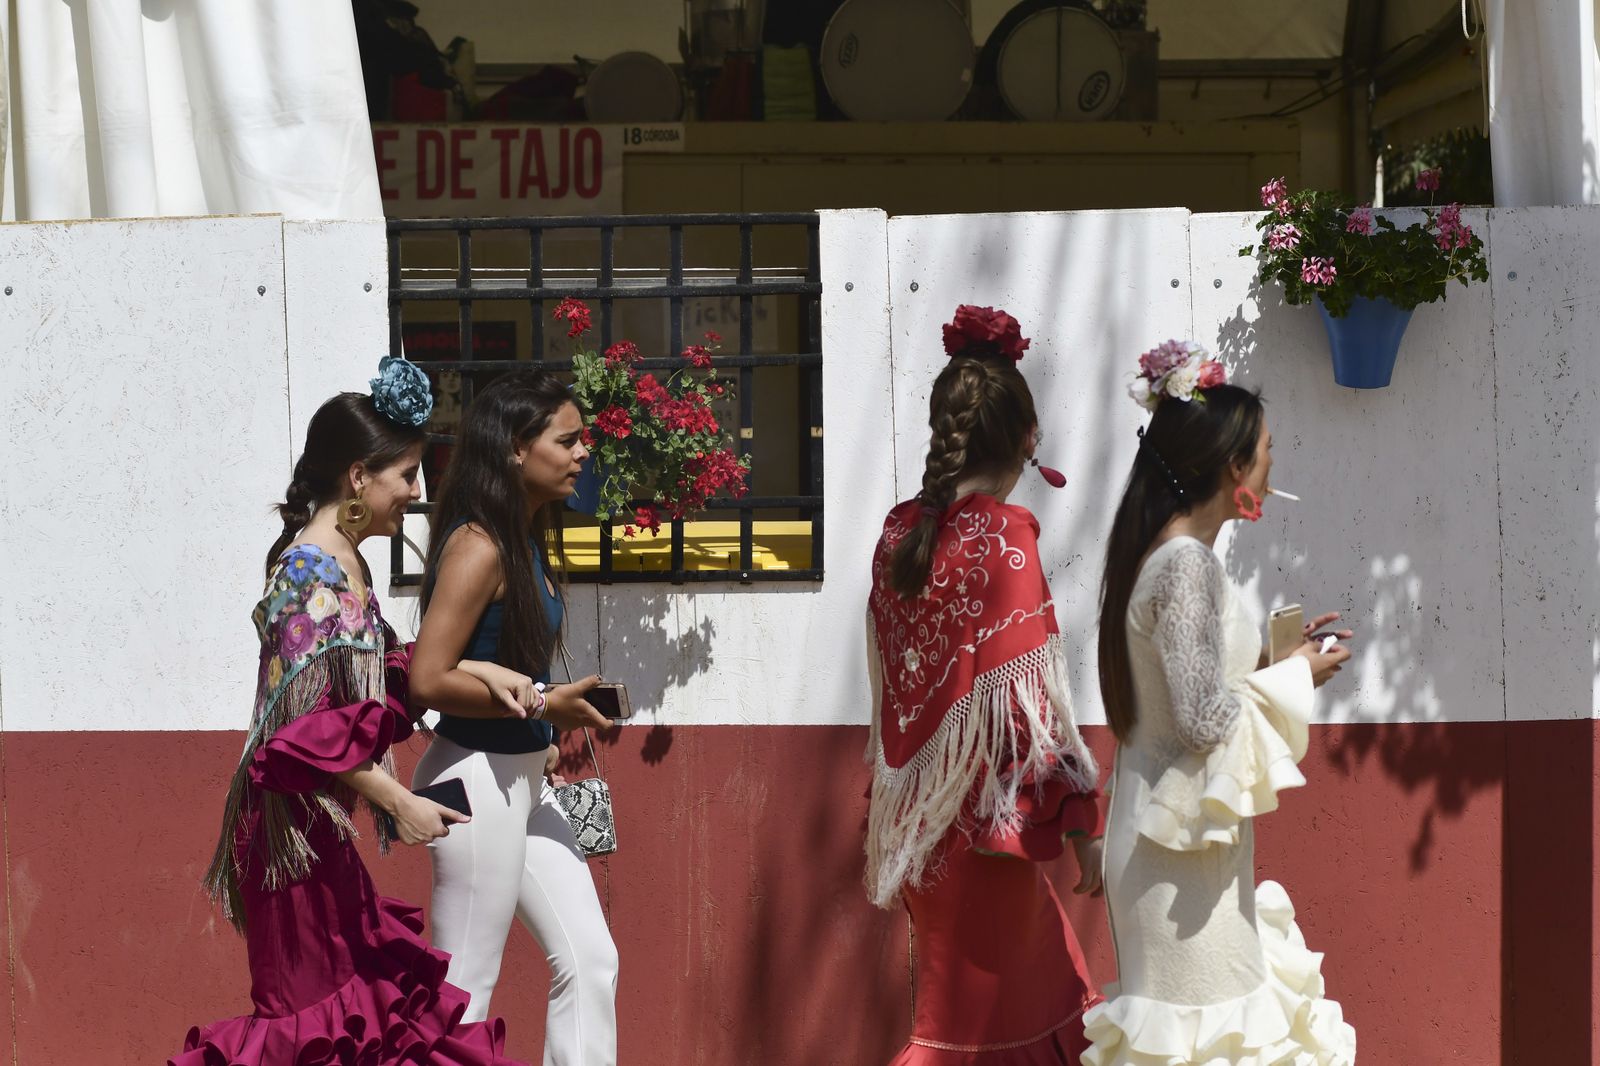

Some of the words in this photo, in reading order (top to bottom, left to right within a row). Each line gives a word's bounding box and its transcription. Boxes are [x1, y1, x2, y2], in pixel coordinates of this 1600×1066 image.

[624, 127, 643, 145] 18
[417, 129, 477, 200] DE
[491, 127, 603, 200] TAJO
